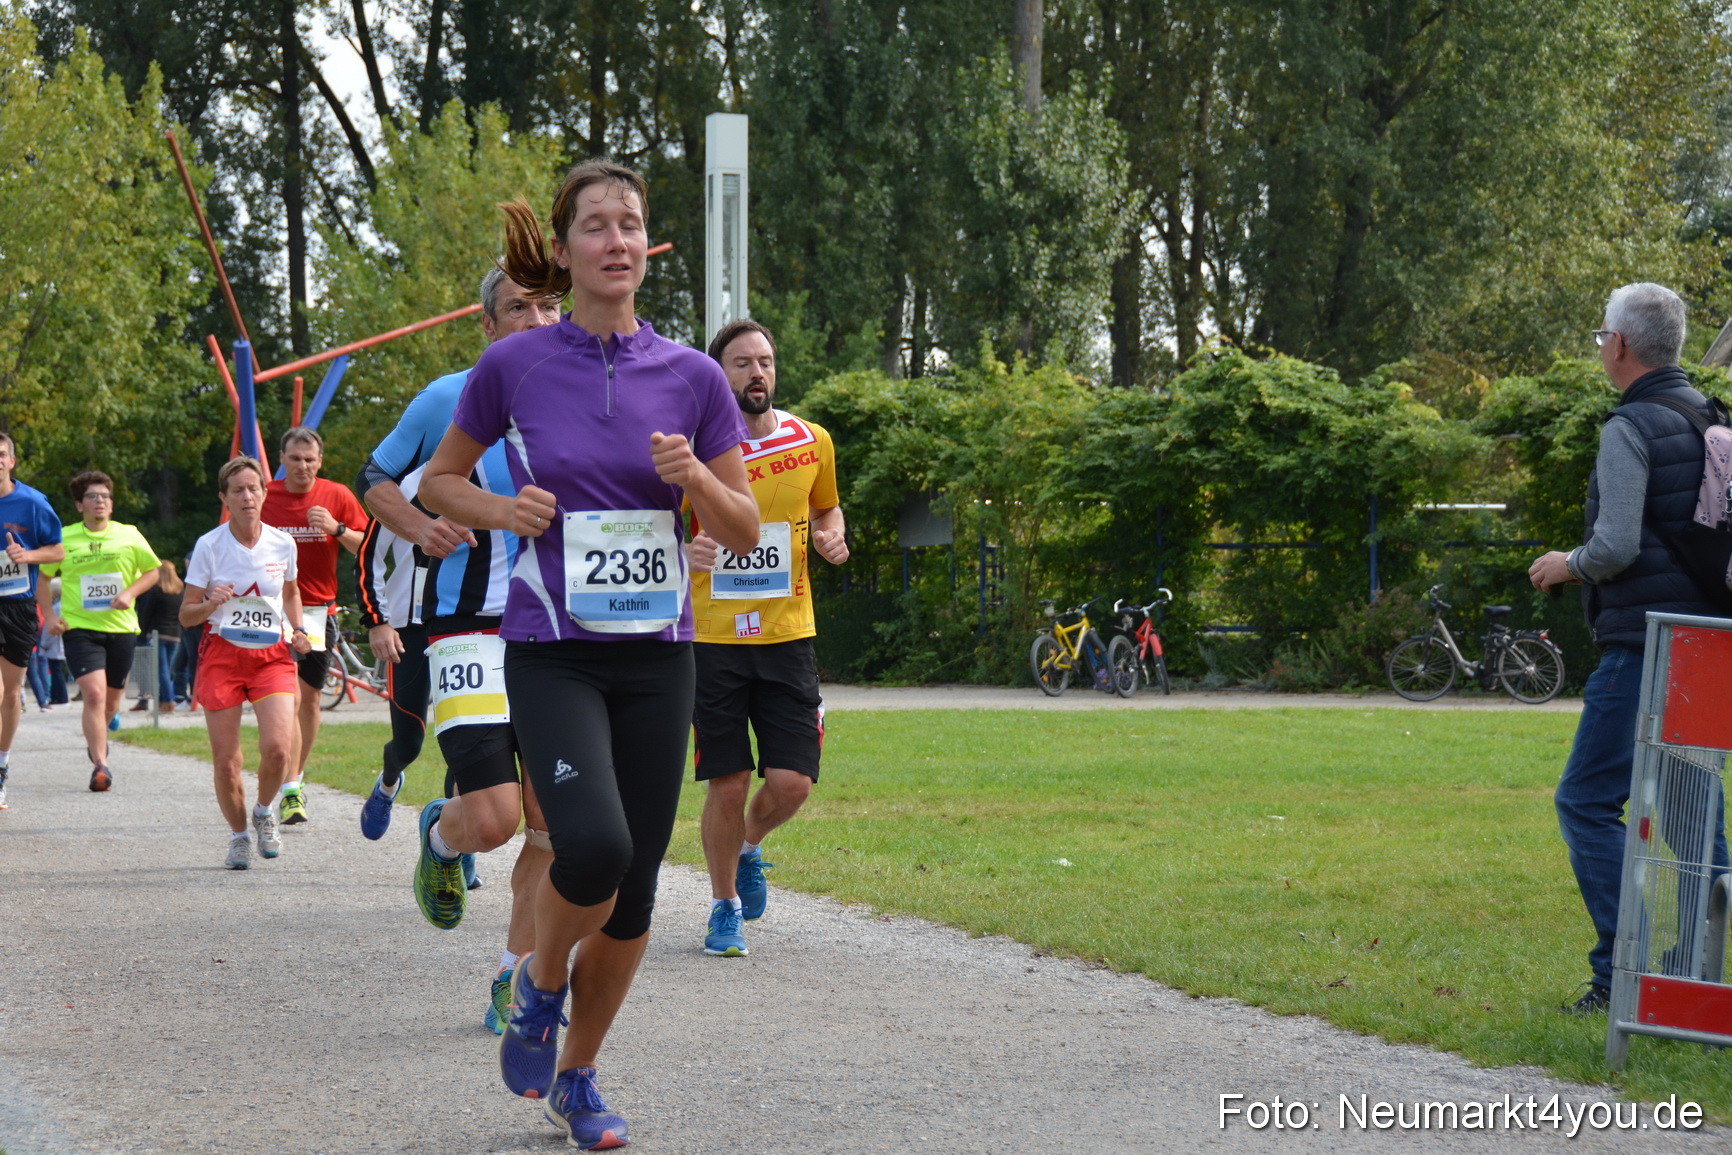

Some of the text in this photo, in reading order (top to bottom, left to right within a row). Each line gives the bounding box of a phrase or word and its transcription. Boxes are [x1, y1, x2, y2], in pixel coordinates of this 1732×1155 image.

[769, 450, 819, 475] BÖGL
[614, 522, 653, 533] BOCK
[722, 546, 780, 570] 2636
[585, 548, 668, 585] 2336
[733, 577, 770, 587] Christian
[87, 584, 118, 597] 2530
[609, 598, 650, 611] Kathrin
[231, 611, 272, 628] 2495
[446, 643, 478, 655] BOCK
[439, 662, 484, 693] 430
